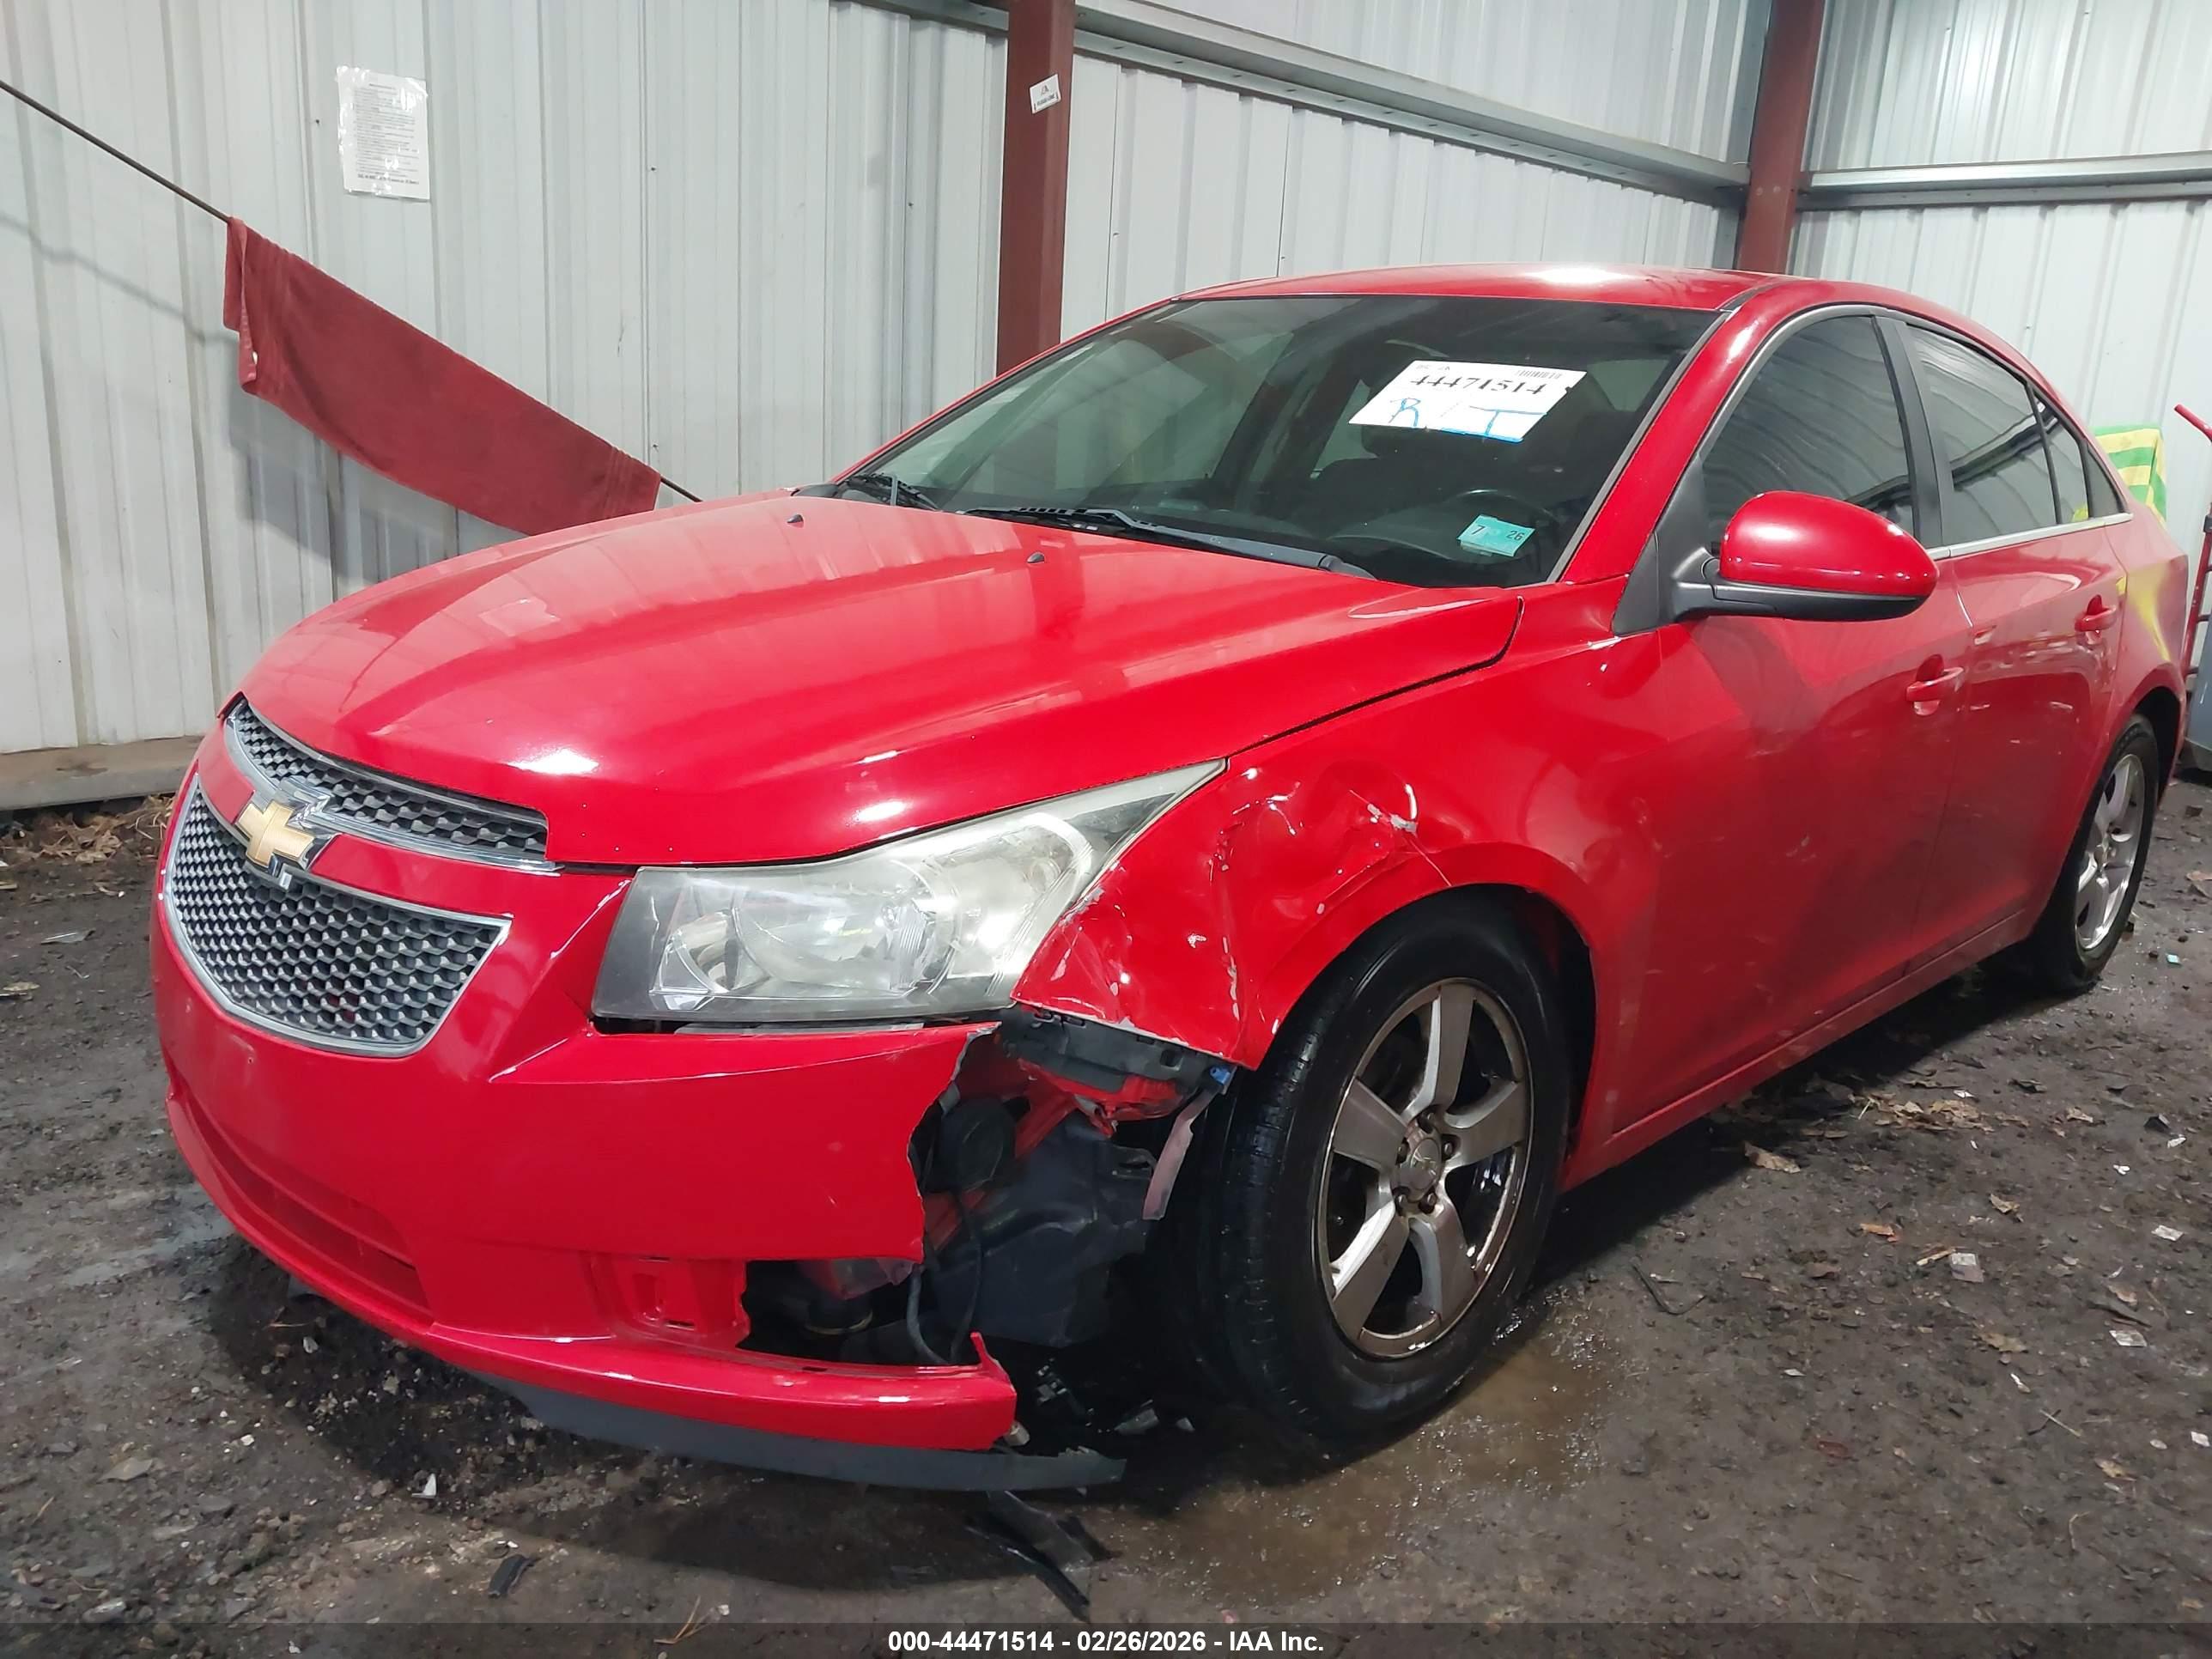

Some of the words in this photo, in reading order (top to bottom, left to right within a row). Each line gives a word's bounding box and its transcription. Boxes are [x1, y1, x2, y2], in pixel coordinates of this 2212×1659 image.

[1409, 374, 1547, 395] 44471514
[1472, 525, 1486, 535] 7
[1506, 530, 1525, 541] 26
